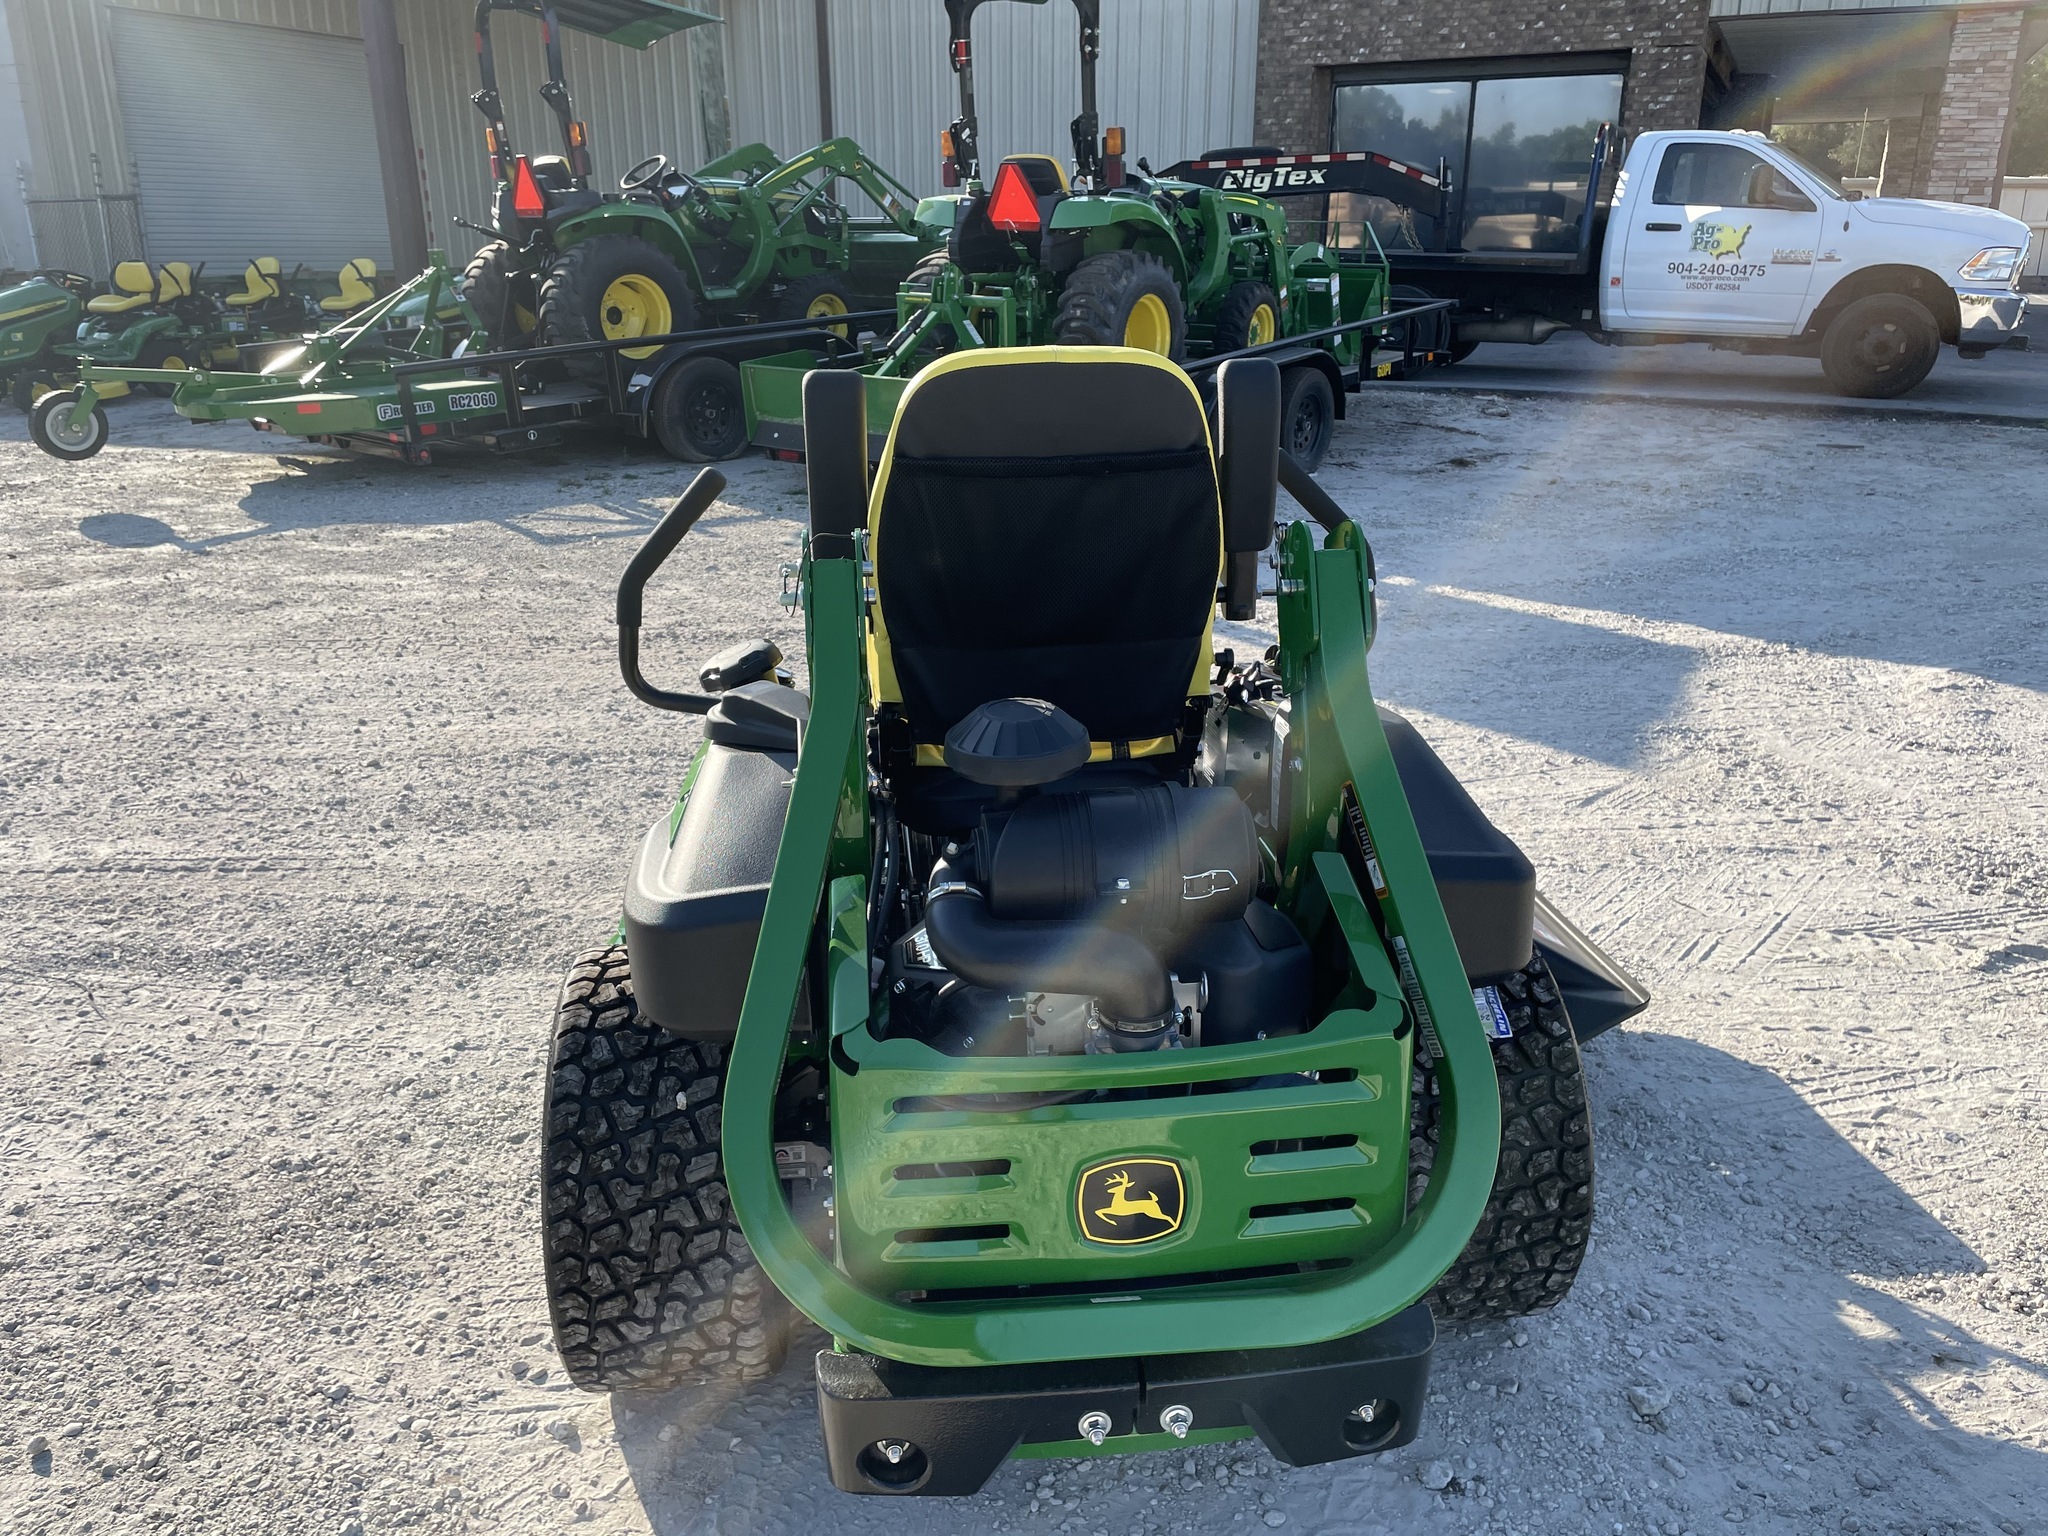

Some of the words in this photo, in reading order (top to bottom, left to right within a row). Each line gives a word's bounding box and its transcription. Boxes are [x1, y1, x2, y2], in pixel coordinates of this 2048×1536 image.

[1222, 166, 1328, 193] BigTex
[1691, 236, 1721, 251] Pro
[1667, 262, 1767, 277] 904-240-0475
[1680, 274, 1750, 283] www.agproco.com
[1685, 282, 1713, 291] USDOT
[379, 401, 434, 420] FRTIER
[450, 392, 497, 410] RC2060
